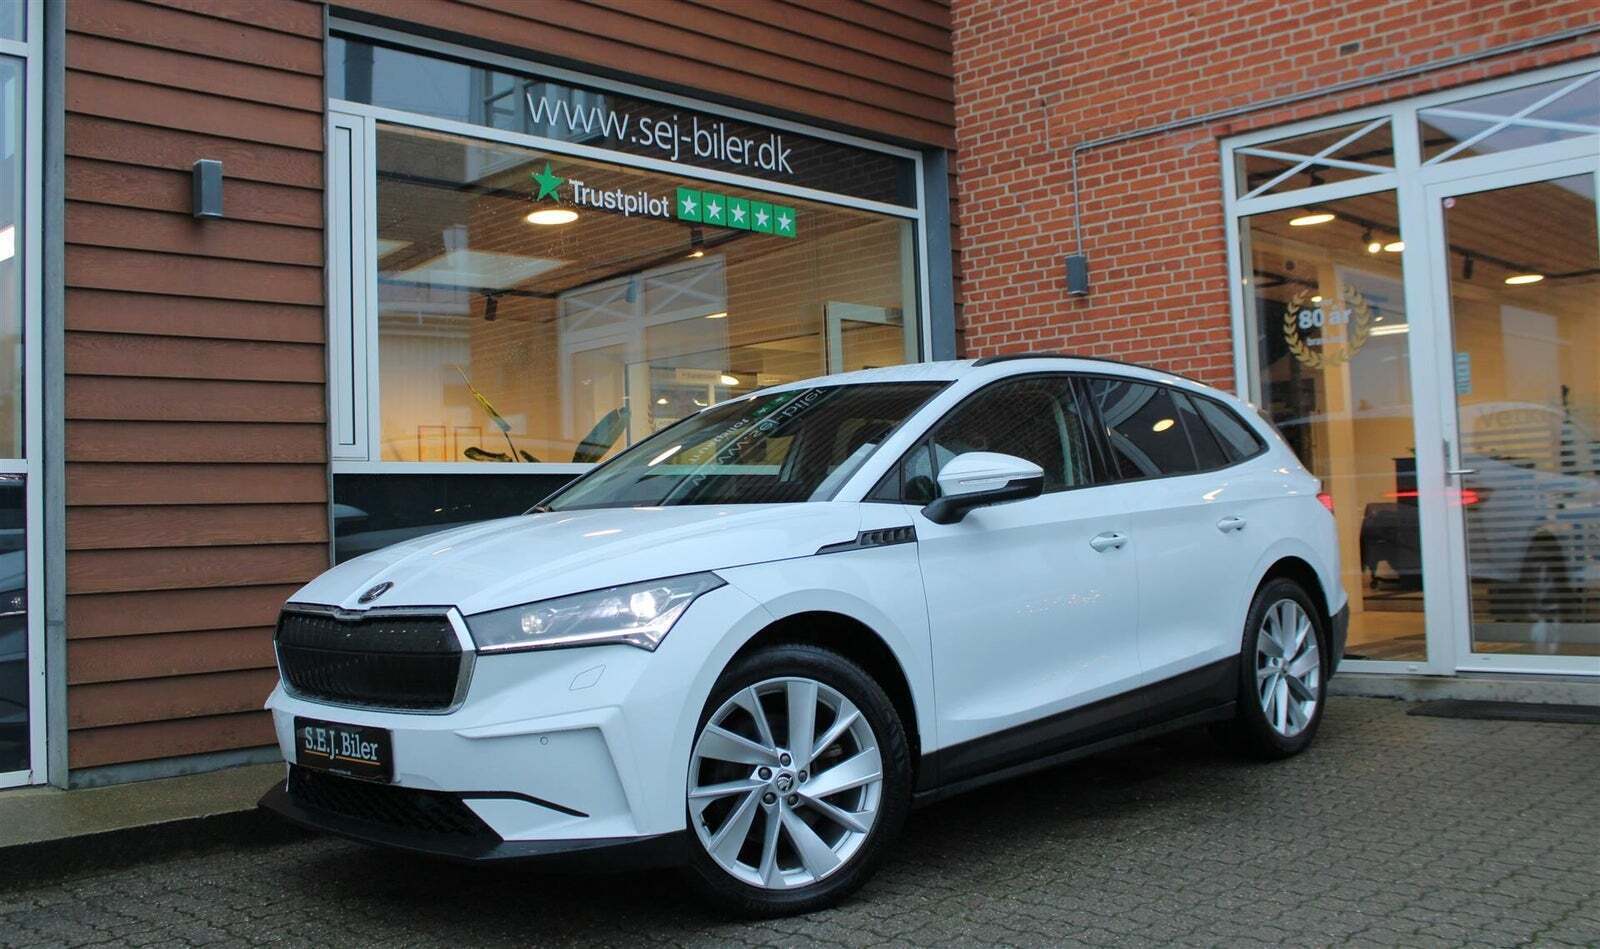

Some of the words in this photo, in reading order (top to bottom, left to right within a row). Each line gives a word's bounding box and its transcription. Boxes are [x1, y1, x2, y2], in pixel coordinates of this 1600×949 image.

[526, 92, 794, 174] www.sej-biler.dk
[568, 179, 670, 218] Trustpilot
[1299, 309, 1325, 329] 80
[305, 726, 338, 760] S.E.J.
[341, 733, 378, 761] Biler
